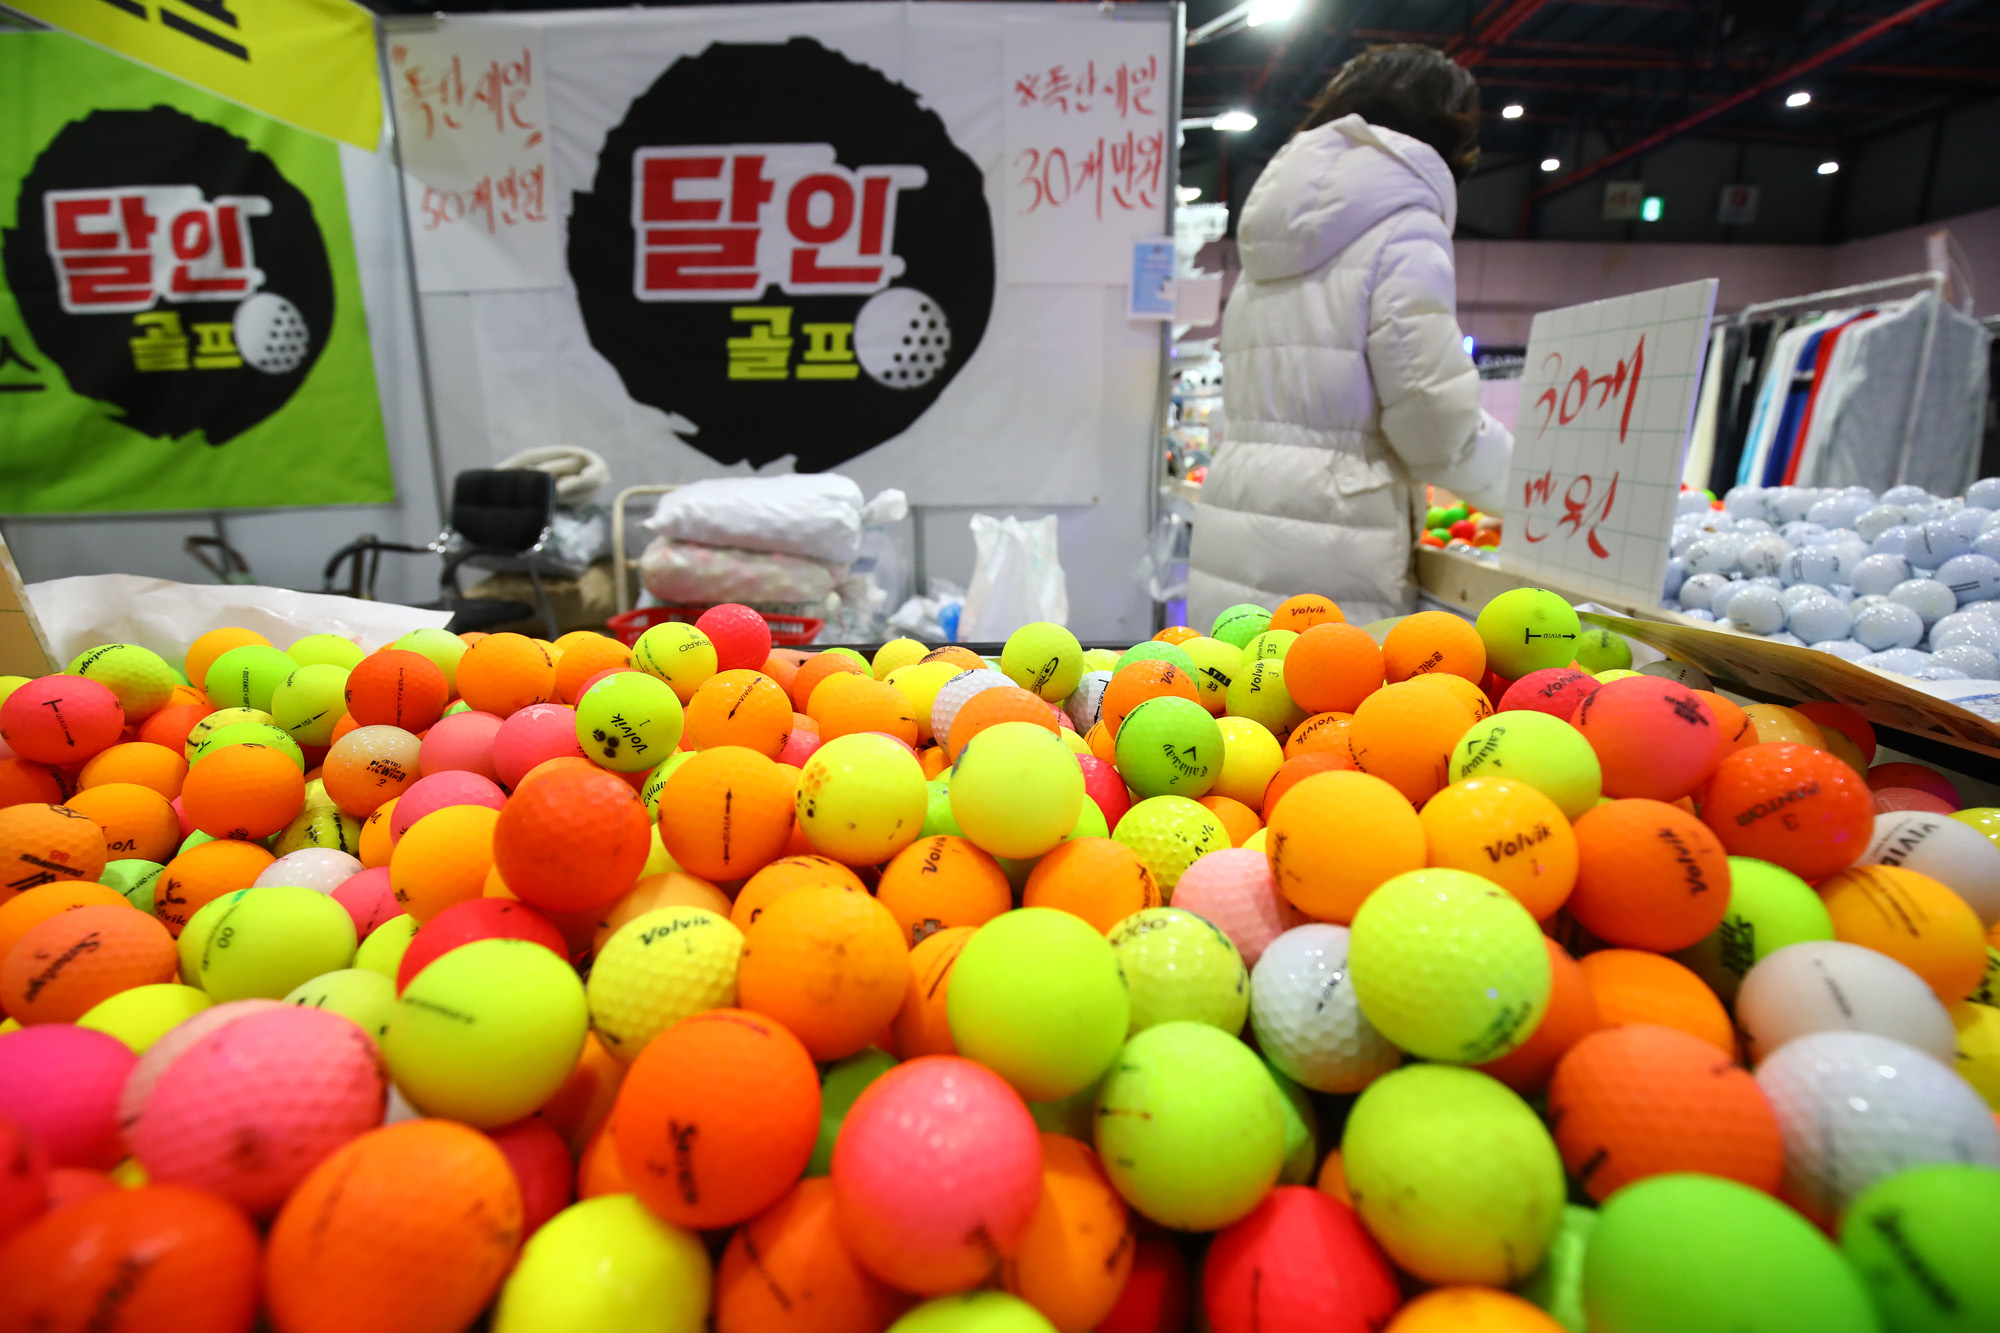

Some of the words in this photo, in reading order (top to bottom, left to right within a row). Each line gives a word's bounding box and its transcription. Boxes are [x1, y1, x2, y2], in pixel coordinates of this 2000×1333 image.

[642, 155, 890, 291] 달인
[53, 195, 250, 306] 달인
[130, 311, 243, 373] 골프
[727, 307, 859, 380] 골프
[1532, 333, 1647, 444] 30개
[1524, 469, 1620, 560] 만원
[1290, 605, 1327, 616] Volvik
[79, 643, 125, 676] Saratoga
[1266, 643, 1277, 655] 33
[738, 685, 754, 702] VIVID
[1206, 680, 1219, 692] 33
[1250, 660, 1267, 694] Volvik
[1539, 671, 1587, 698] Volvik
[611, 713, 649, 755] Volvik
[1296, 716, 1338, 745] Volvik
[1163, 743, 1209, 778] Callaway
[1169, 775, 1181, 785] 2
[723, 813, 732, 844] VIVID
[1483, 822, 1554, 864] Volvik
[1658, 827, 1709, 897] Volvik
[638, 917, 713, 947] Volvik
